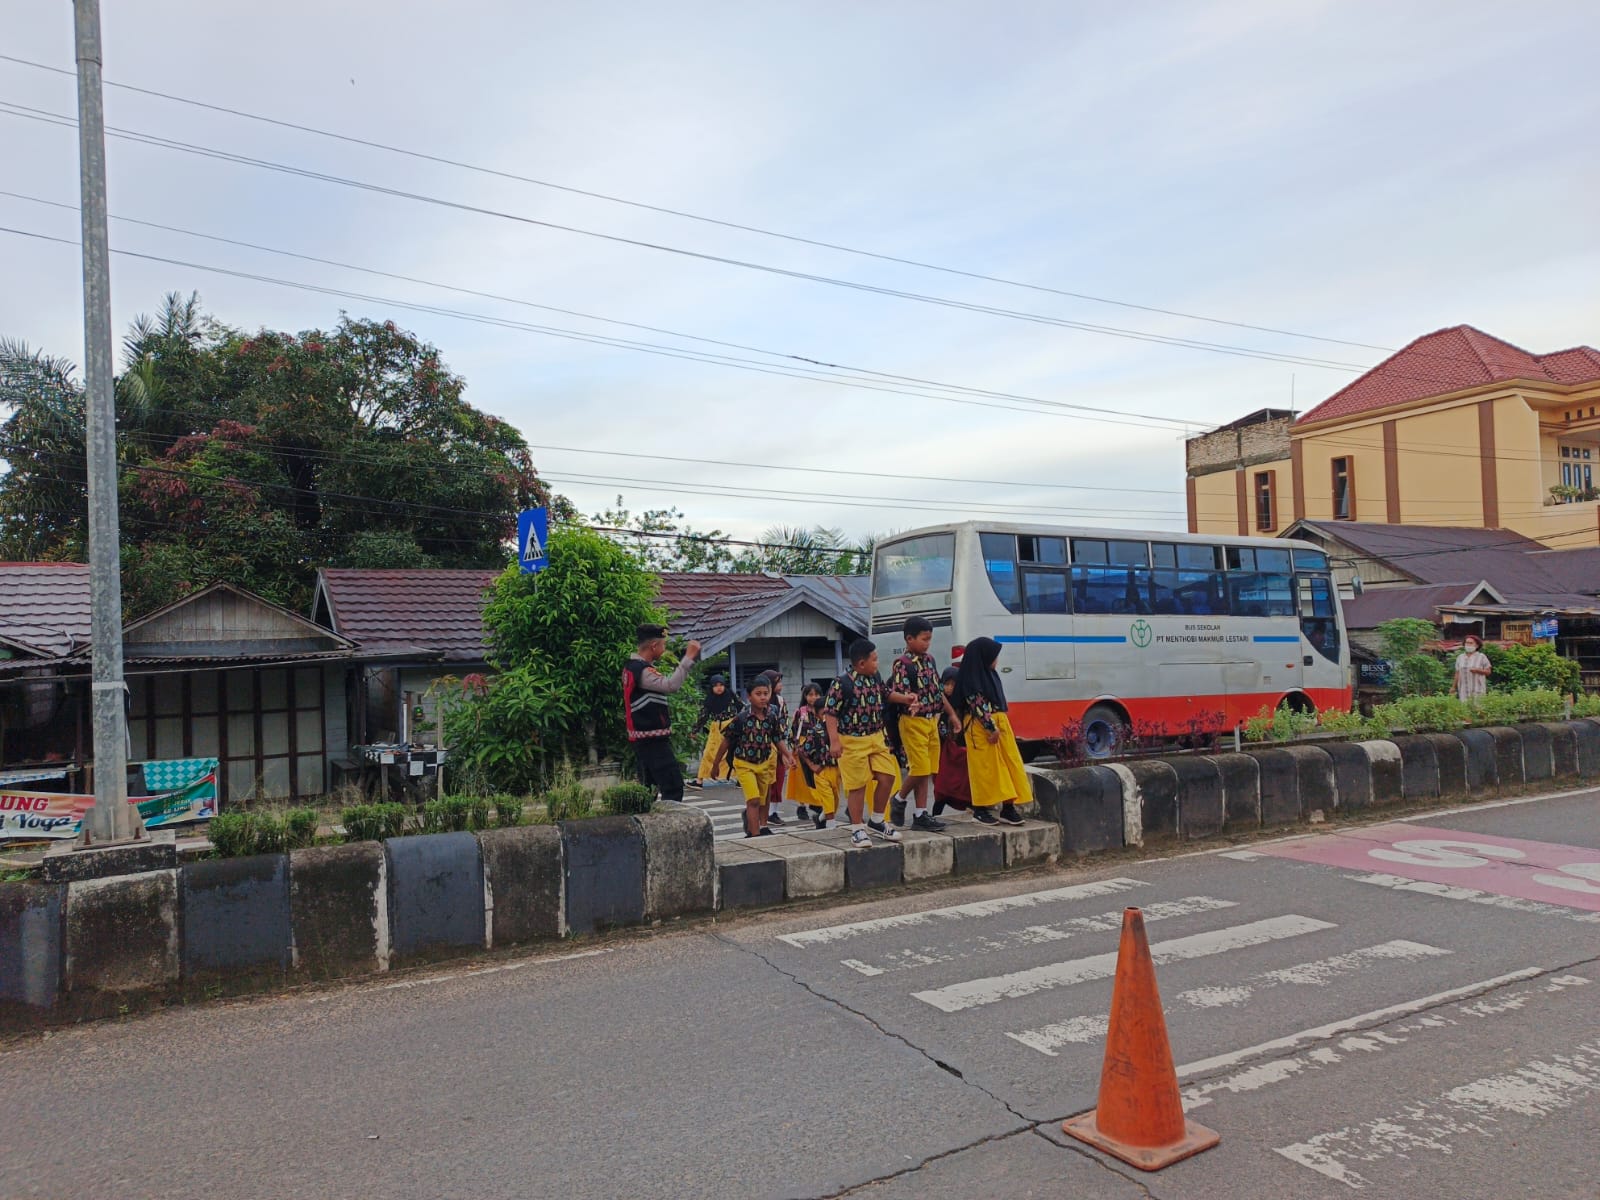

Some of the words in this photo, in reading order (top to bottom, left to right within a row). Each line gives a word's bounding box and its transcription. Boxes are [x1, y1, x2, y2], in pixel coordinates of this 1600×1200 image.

[1156, 635, 1164, 643] PT
[1165, 635, 1198, 643] MENTHOBI
[1198, 635, 1224, 643] MAKMUR
[1225, 635, 1249, 643] LESTARI
[12, 813, 72, 831] Yoga
